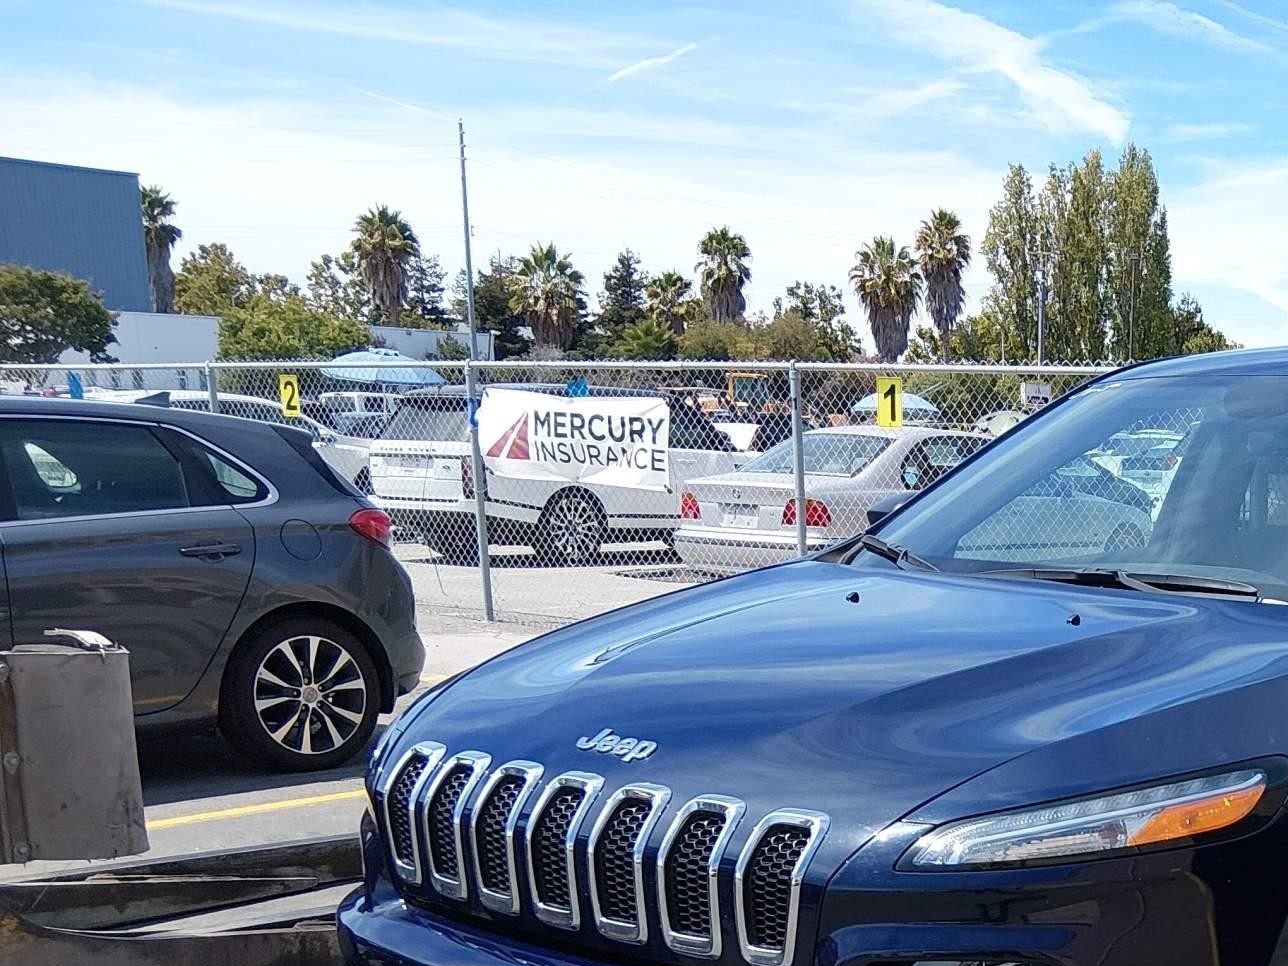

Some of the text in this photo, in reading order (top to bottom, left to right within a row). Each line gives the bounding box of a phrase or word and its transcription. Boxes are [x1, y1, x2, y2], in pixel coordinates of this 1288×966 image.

[283, 380, 298, 411] 2
[883, 383, 897, 422] 1
[533, 410, 666, 445] MERCURY
[534, 440, 666, 472] INSURANCE
[575, 727, 658, 764] Jeep
